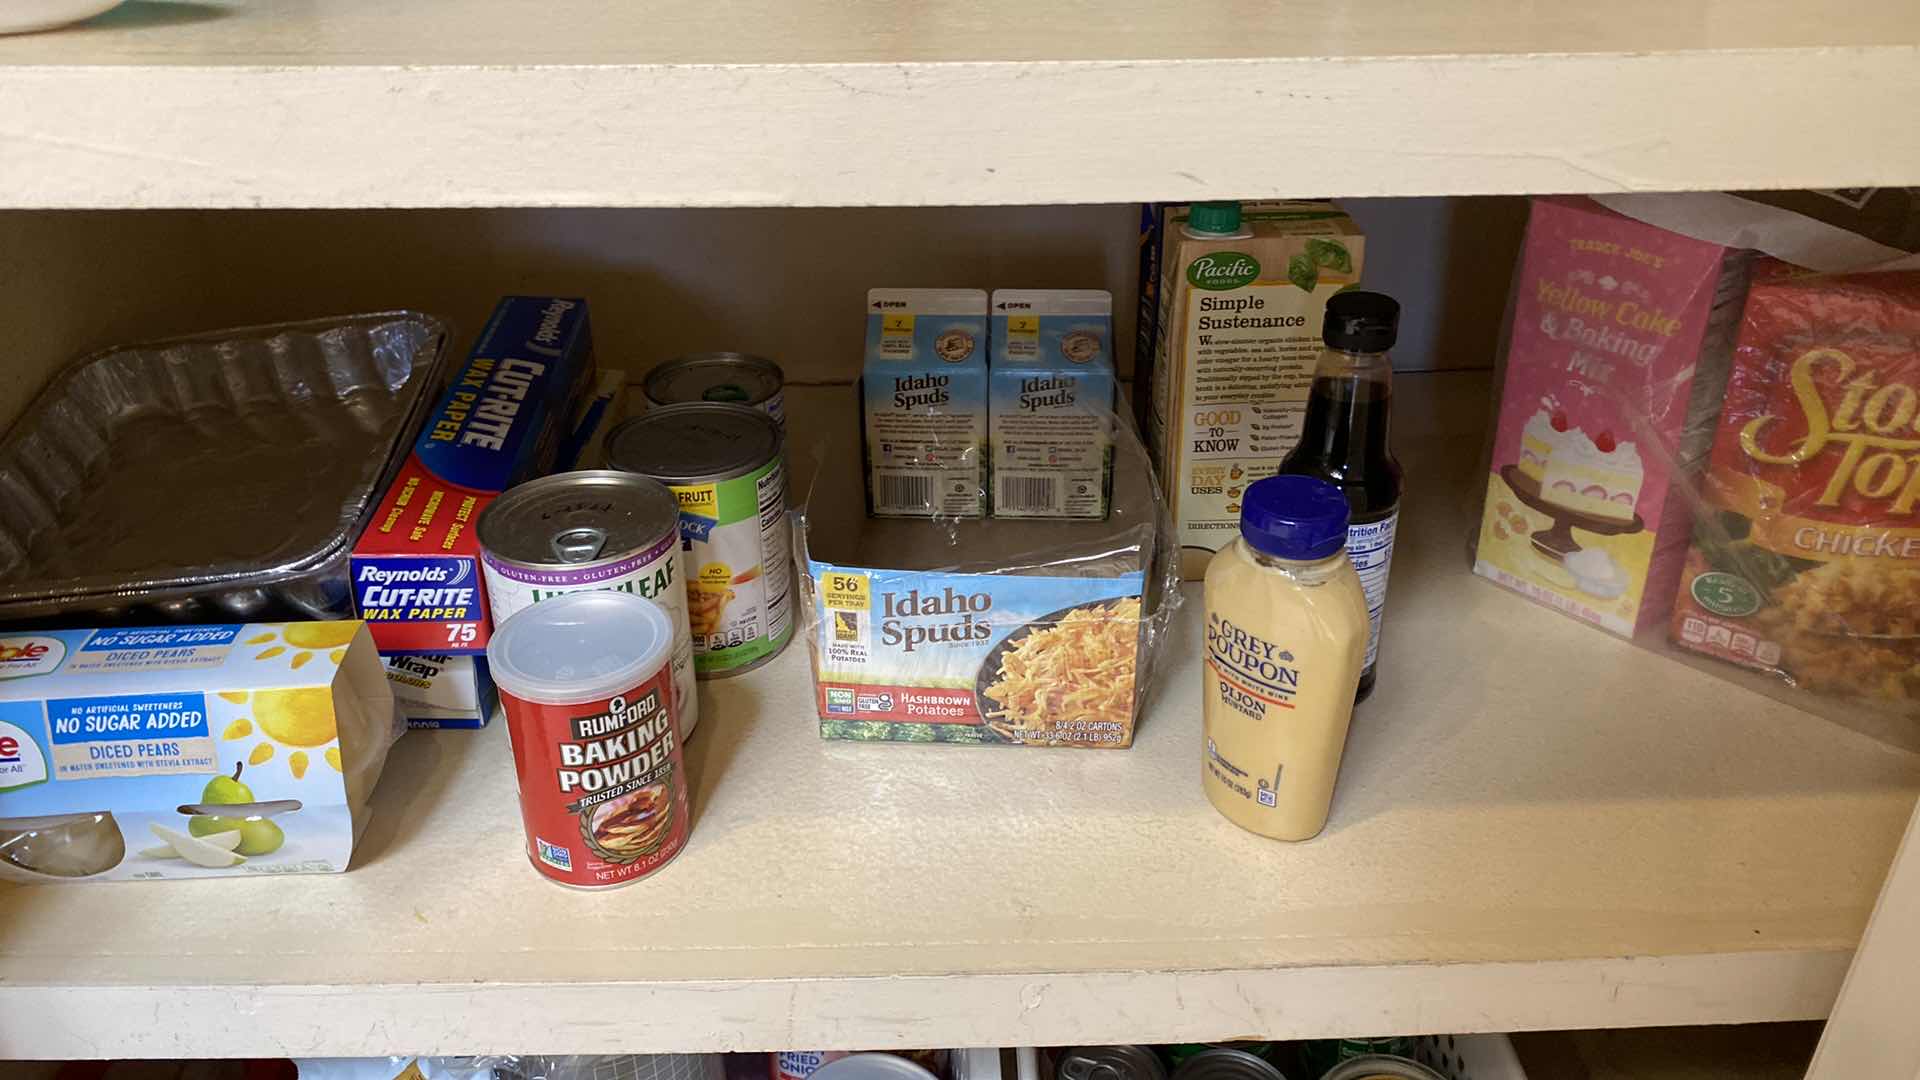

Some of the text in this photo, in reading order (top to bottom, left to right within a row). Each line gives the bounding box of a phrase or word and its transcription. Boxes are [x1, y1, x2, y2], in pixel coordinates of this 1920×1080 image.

[1193, 257, 1255, 278] Pacific
[1200, 296, 1265, 313] Simple
[1535, 278, 1682, 337] Yellow Cake
[1198, 314, 1305, 330] Sustenance
[1540, 313, 1659, 368] & Baking
[463, 357, 497, 391] WAX
[1567, 350, 1615, 384] Mix
[895, 373, 949, 392] Idaho
[1022, 376, 1075, 394] Idaho
[460, 358, 545, 452] CUT-RITE
[894, 388, 949, 411] Spuds
[1019, 390, 1075, 412] Spuds
[1740, 348, 1920, 464] Sto
[430, 391, 480, 442] PAPER
[1194, 411, 1241, 426] GOOD
[1209, 428, 1224, 437] TO
[1192, 439, 1240, 452] KNOW
[1192, 474, 1226, 486] DAY
[679, 490, 712, 503] FRUIT
[1191, 487, 1223, 495] USES
[680, 520, 706, 534] OCK
[1348, 525, 1378, 538] trition
[1795, 527, 1920, 557] CHICKE
[500, 555, 652, 583] GLUTEN-FREE GLUTEN-FREE
[1353, 560, 1368, 569] ries
[358, 566, 448, 587] Reynolds
[833, 576, 858, 591] 56
[362, 586, 474, 608] CUT-RITE
[881, 587, 993, 618] Idaho
[1719, 586, 1733, 604] 5
[363, 607, 467, 620] WAX PAPER
[90, 631, 234, 647] NO SUGAR ADDED
[445, 624, 478, 643] 75
[882, 614, 992, 653] Spuds
[1222, 620, 1279, 660] GREY
[0, 642, 49, 660] ole
[106, 648, 197, 662] DICED PEARS
[829, 648, 849, 656] 100%
[1208, 624, 1300, 687] POUPON
[389, 655, 439, 679] Wrap
[900, 692, 971, 706] HASHBROWN
[1220, 681, 1266, 715] DIJON
[1221, 693, 1262, 721] MUSTARD
[71, 702, 183, 715] NO ARTIFICIAL SWEETENERS
[579, 694, 657, 738] RUMFORD
[907, 705, 965, 717] Potatoes
[56, 711, 202, 734] NO SUGAR ADDED
[1088, 722, 1122, 732] CARTONS
[559, 708, 669, 767] BAKING
[90, 742, 180, 759] DICED PEARS
[558, 731, 674, 793] POWDER
[580, 786, 624, 808] TRUSTED
[626, 776, 653, 791] SINCE
[596, 869, 615, 881] NET
[616, 866, 632, 877] WT
[648, 852, 660, 865] OZ
[779, 1051, 820, 1066] FRIED
[779, 1060, 817, 1074] ONIO
